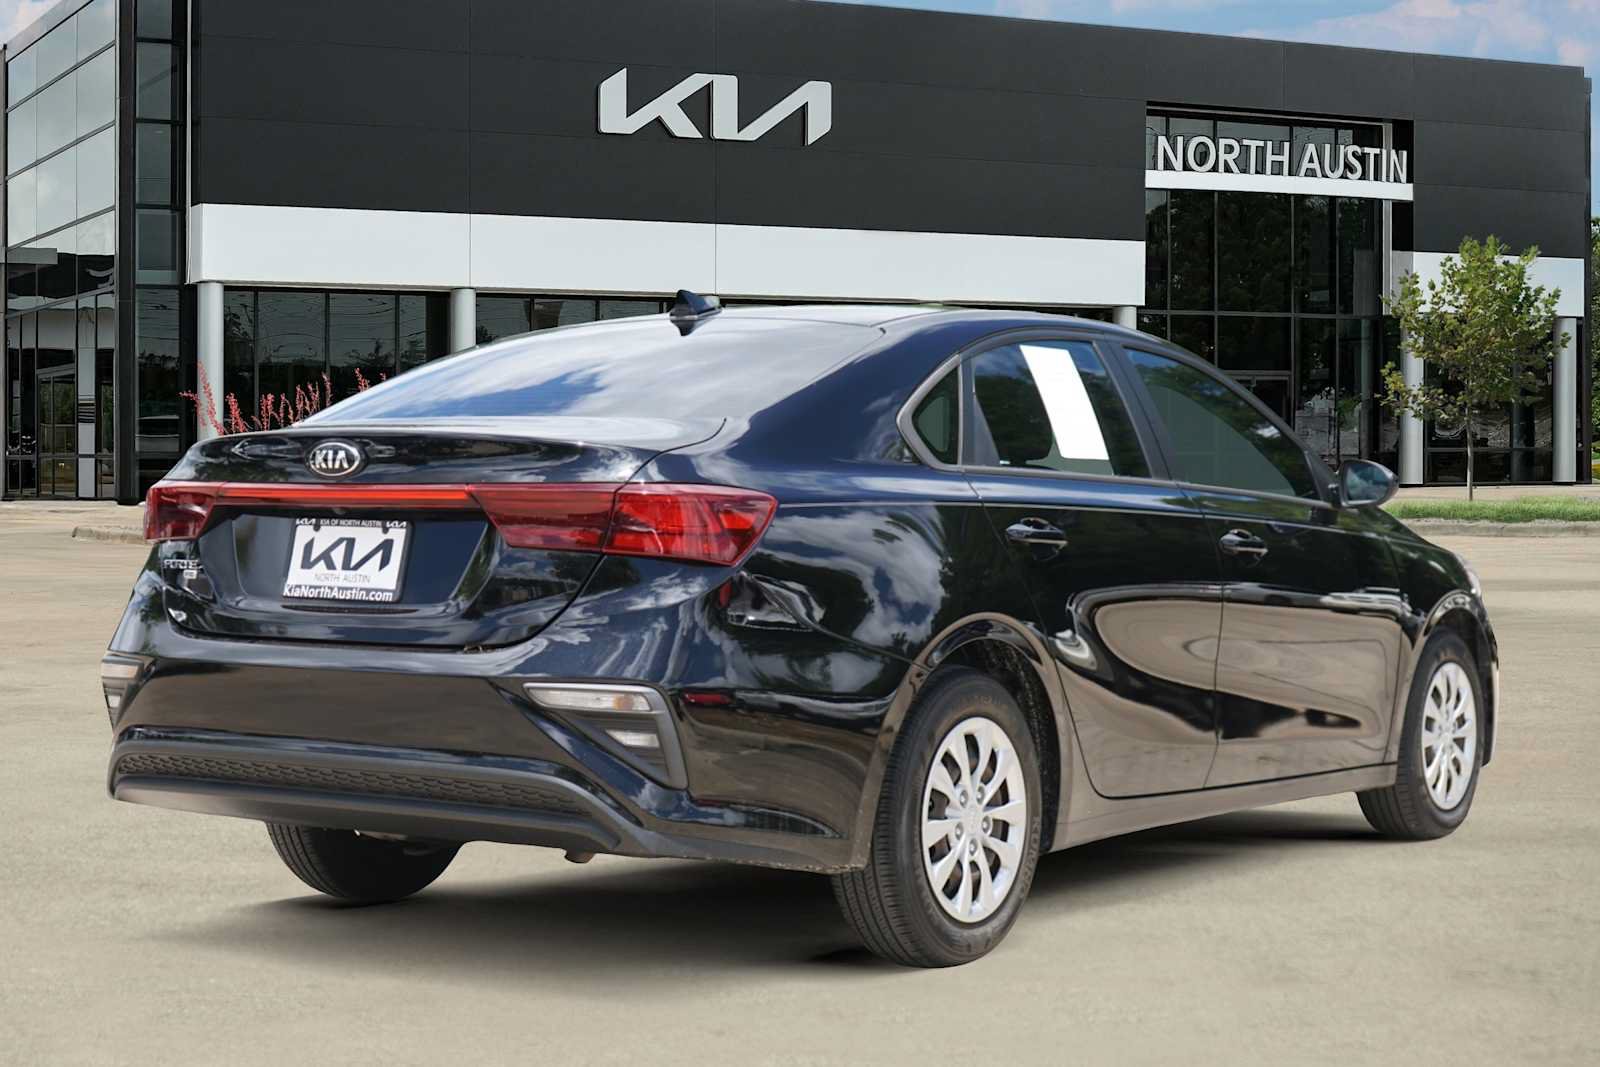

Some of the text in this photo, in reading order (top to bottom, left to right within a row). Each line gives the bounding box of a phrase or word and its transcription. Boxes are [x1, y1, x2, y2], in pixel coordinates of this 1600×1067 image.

[598, 67, 832, 146] KIA
[1156, 134, 1408, 184] NORTH AUSTIN
[315, 449, 349, 469] KIA
[320, 518, 383, 529] KIA OF NORTH AUSTIN
[300, 536, 394, 572] KIA
[315, 573, 371, 584] NORTH AUSTIN
[283, 585, 393, 602] KiaNorthAustin.com
